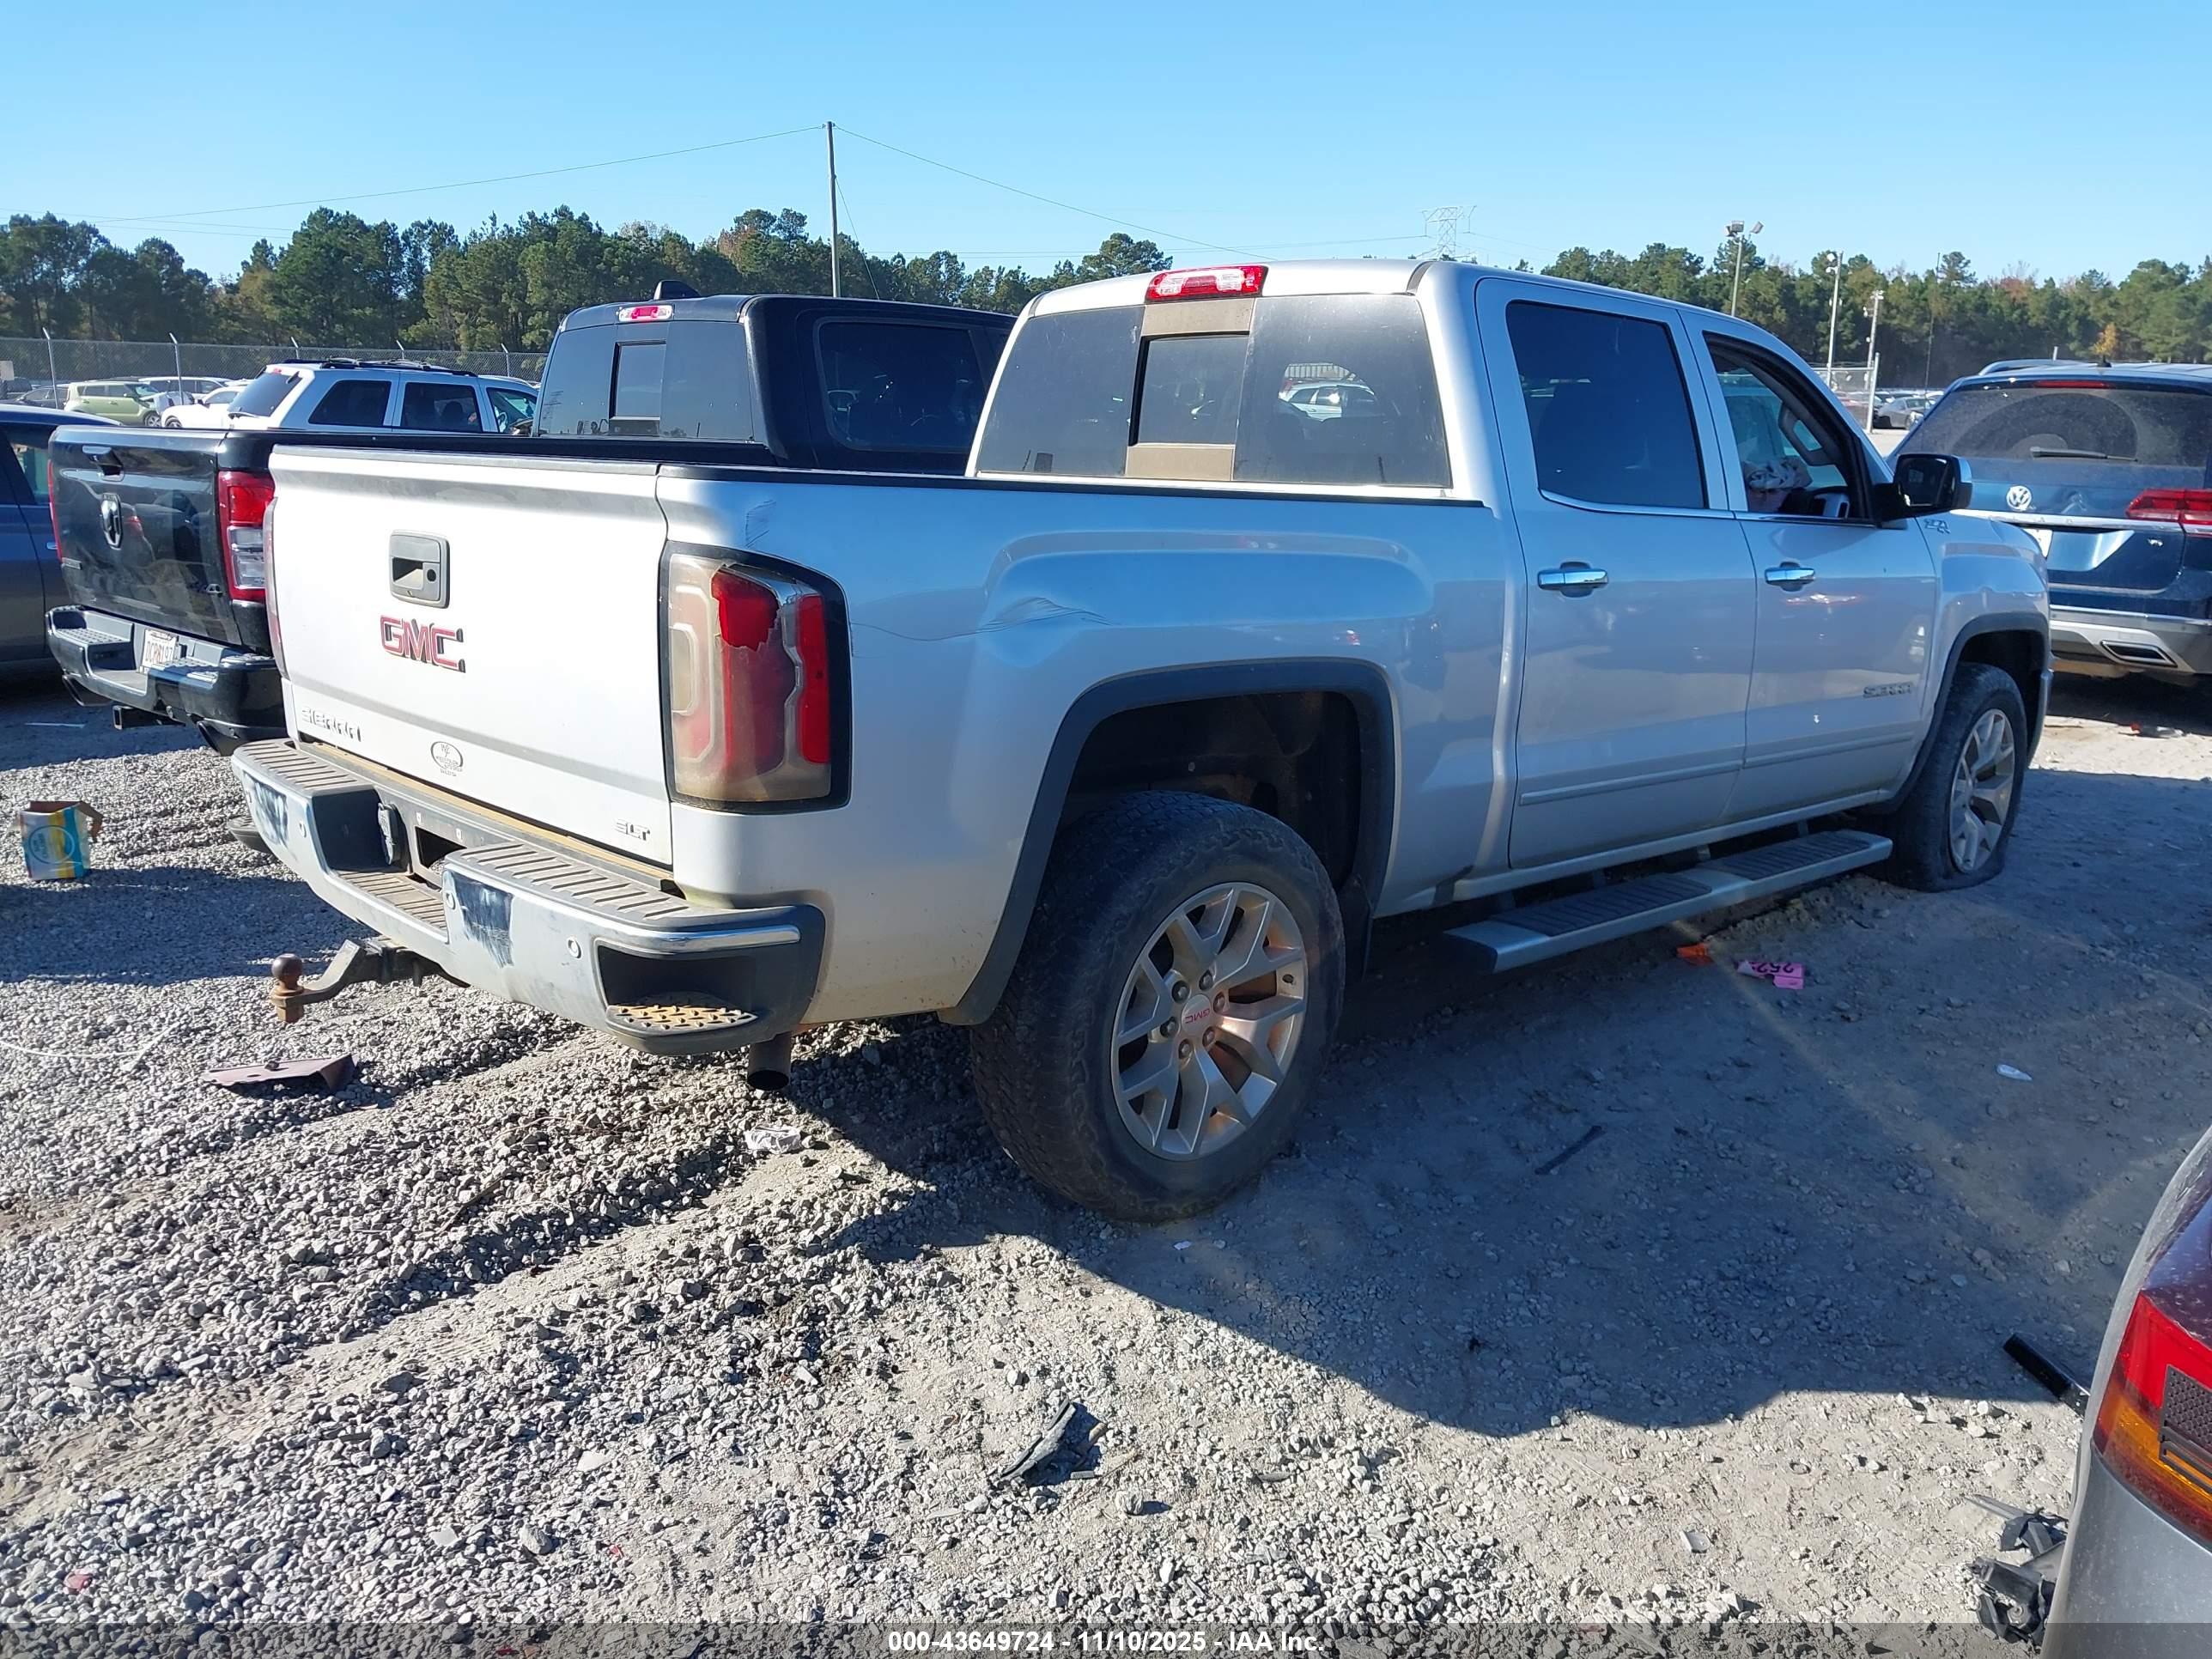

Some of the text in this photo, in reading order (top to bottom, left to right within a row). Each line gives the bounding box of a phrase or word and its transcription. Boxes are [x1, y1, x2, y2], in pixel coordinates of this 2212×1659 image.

[380, 615, 466, 673] GMC
[1750, 961, 1794, 973] 252
[1184, 1008, 1211, 1024] GMC
